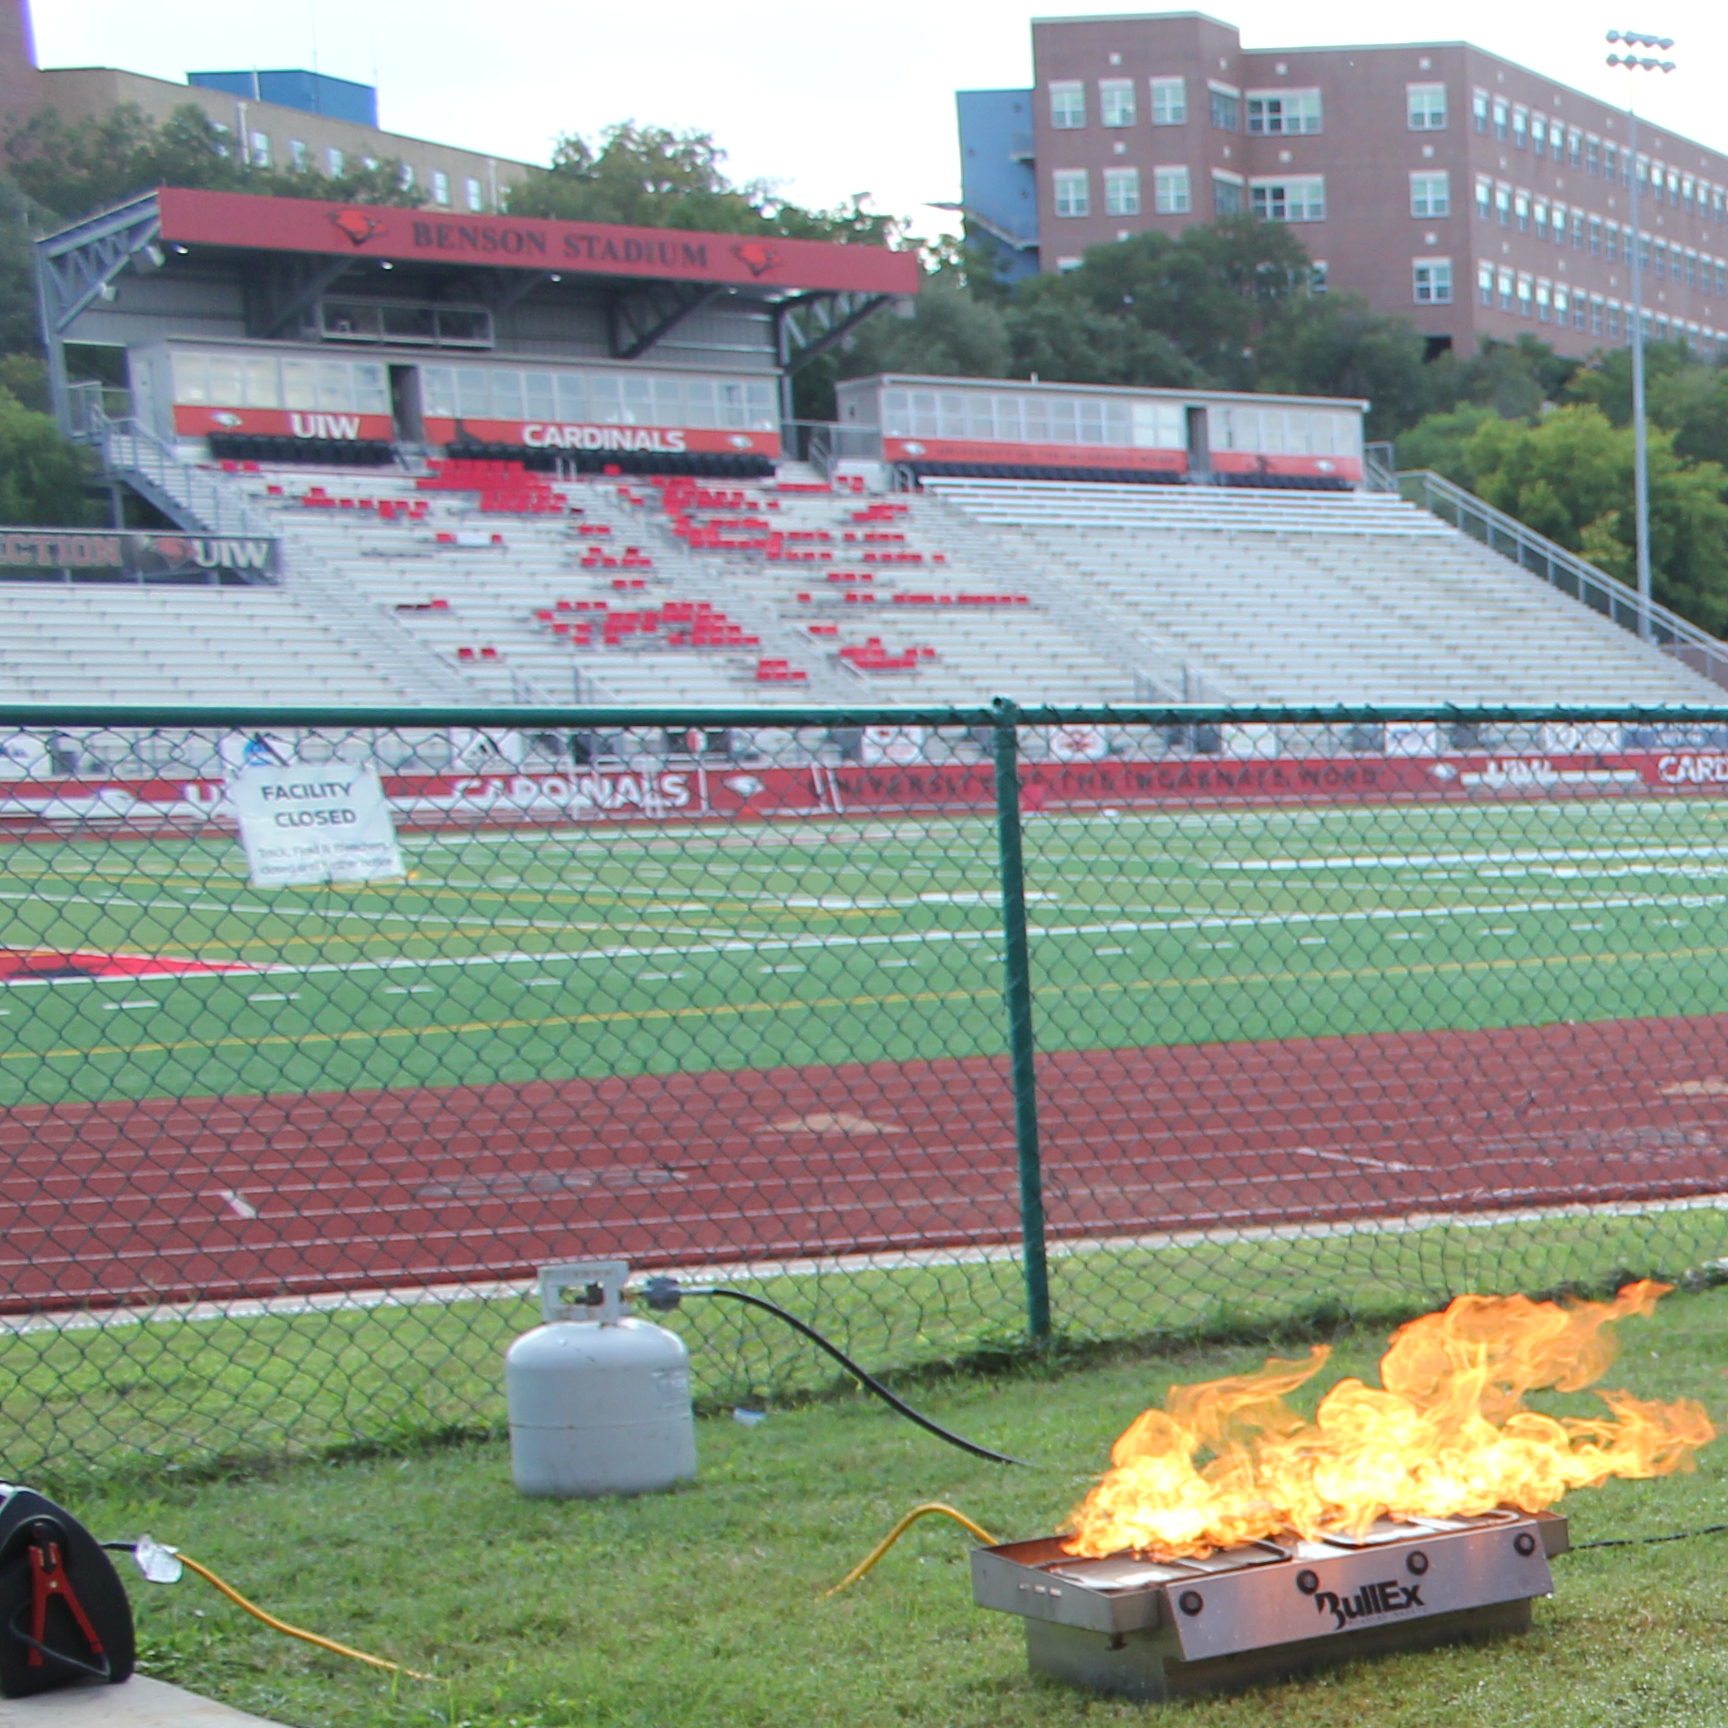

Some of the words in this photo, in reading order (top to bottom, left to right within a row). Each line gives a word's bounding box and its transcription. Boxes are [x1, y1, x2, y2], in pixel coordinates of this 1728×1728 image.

[413, 221, 548, 255] BENSON
[563, 232, 709, 268] STADIUM
[290, 413, 360, 440] UIW
[522, 424, 688, 454] CARDINALS
[194, 538, 269, 569] UIW
[260, 783, 353, 802] FACILITY
[453, 774, 690, 808] CARDNALS
[275, 809, 357, 828] CLOSED
[1314, 1579, 1425, 1631] BullEx
